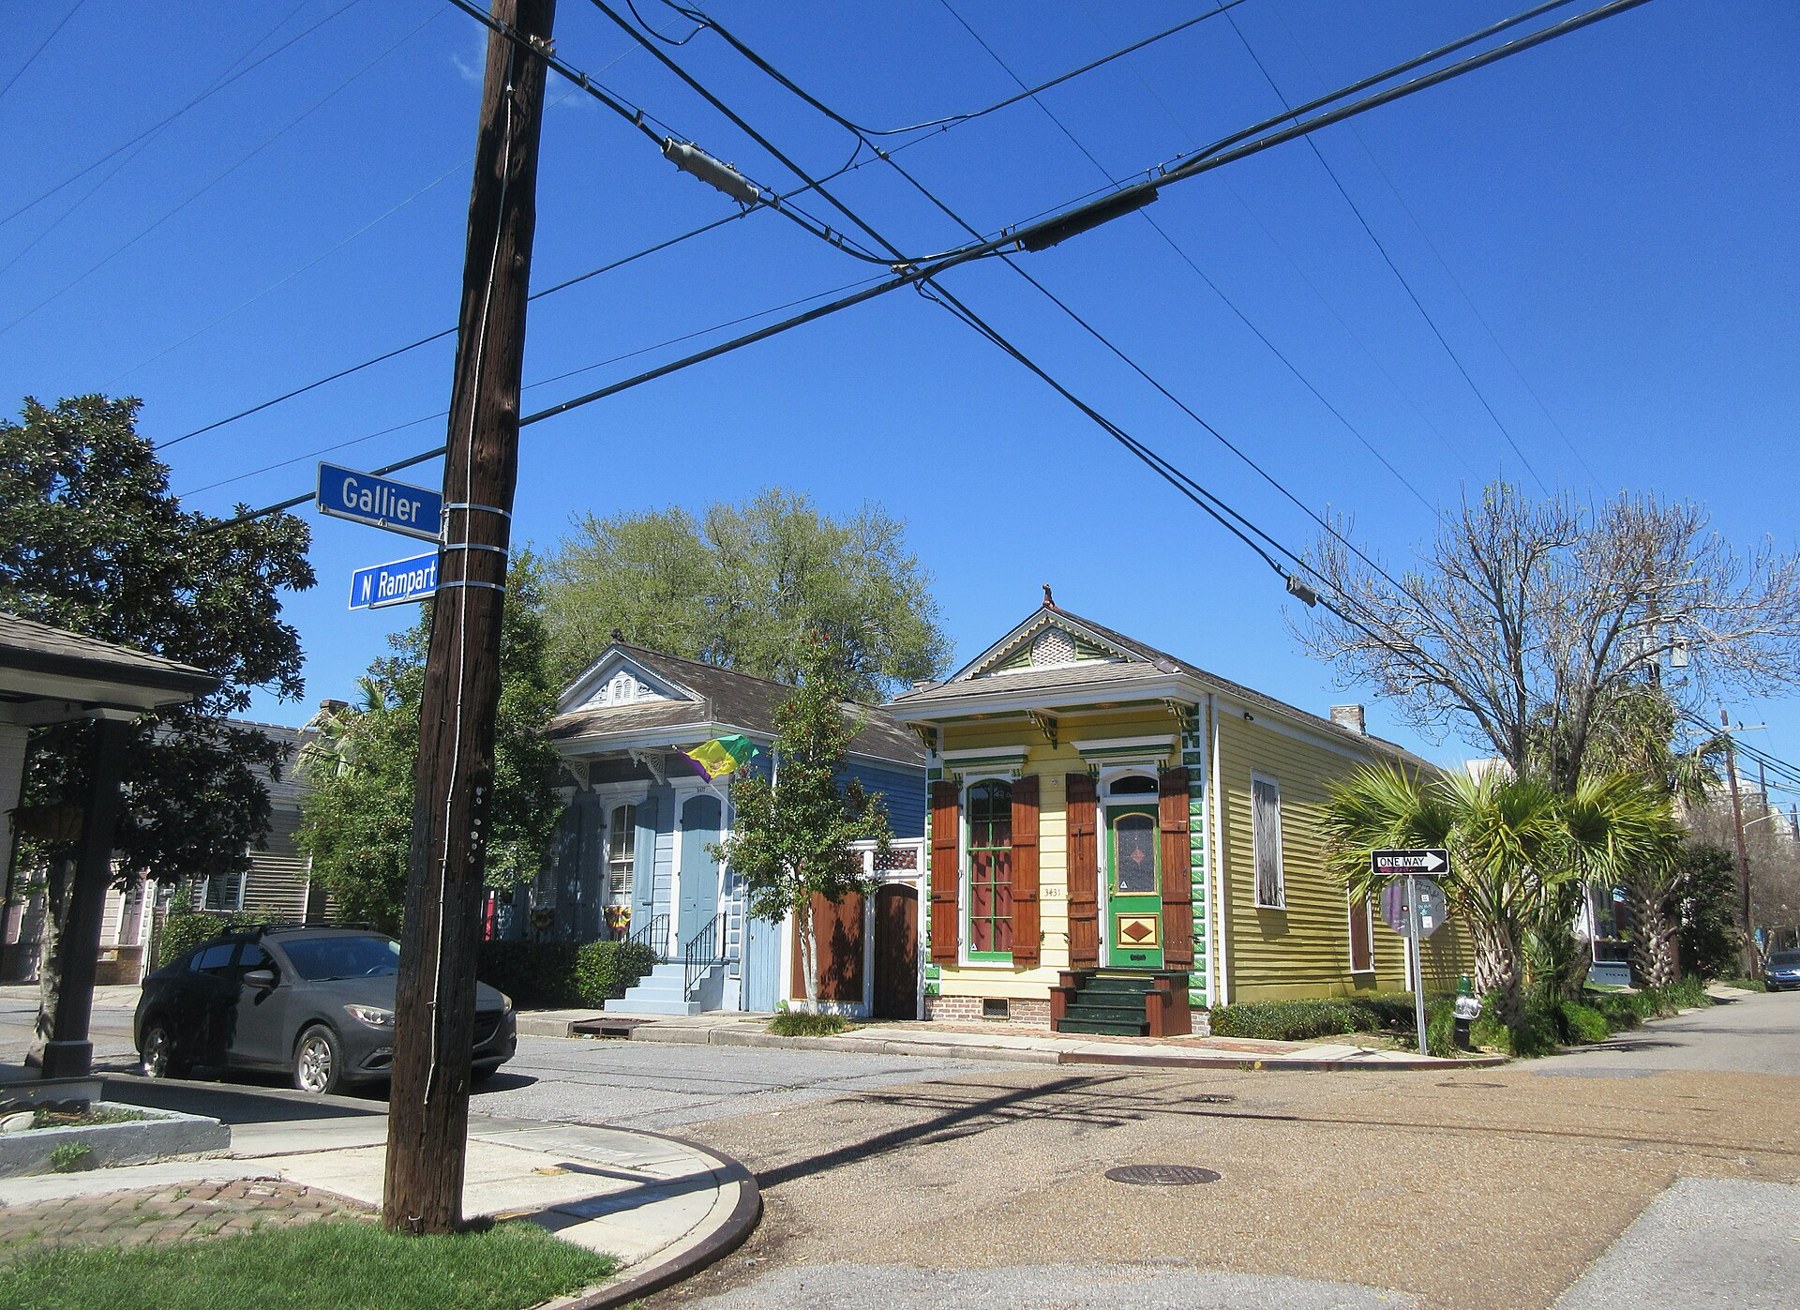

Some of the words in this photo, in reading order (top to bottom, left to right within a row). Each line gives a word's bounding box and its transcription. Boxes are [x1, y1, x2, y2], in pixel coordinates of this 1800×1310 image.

[342, 477, 422, 523] Gallier
[361, 575, 373, 602] N
[378, 560, 436, 598] Rampart
[1379, 857, 1400, 867] ONE
[1402, 857, 1425, 867] WAY
[1044, 888, 1061, 897] 3431
